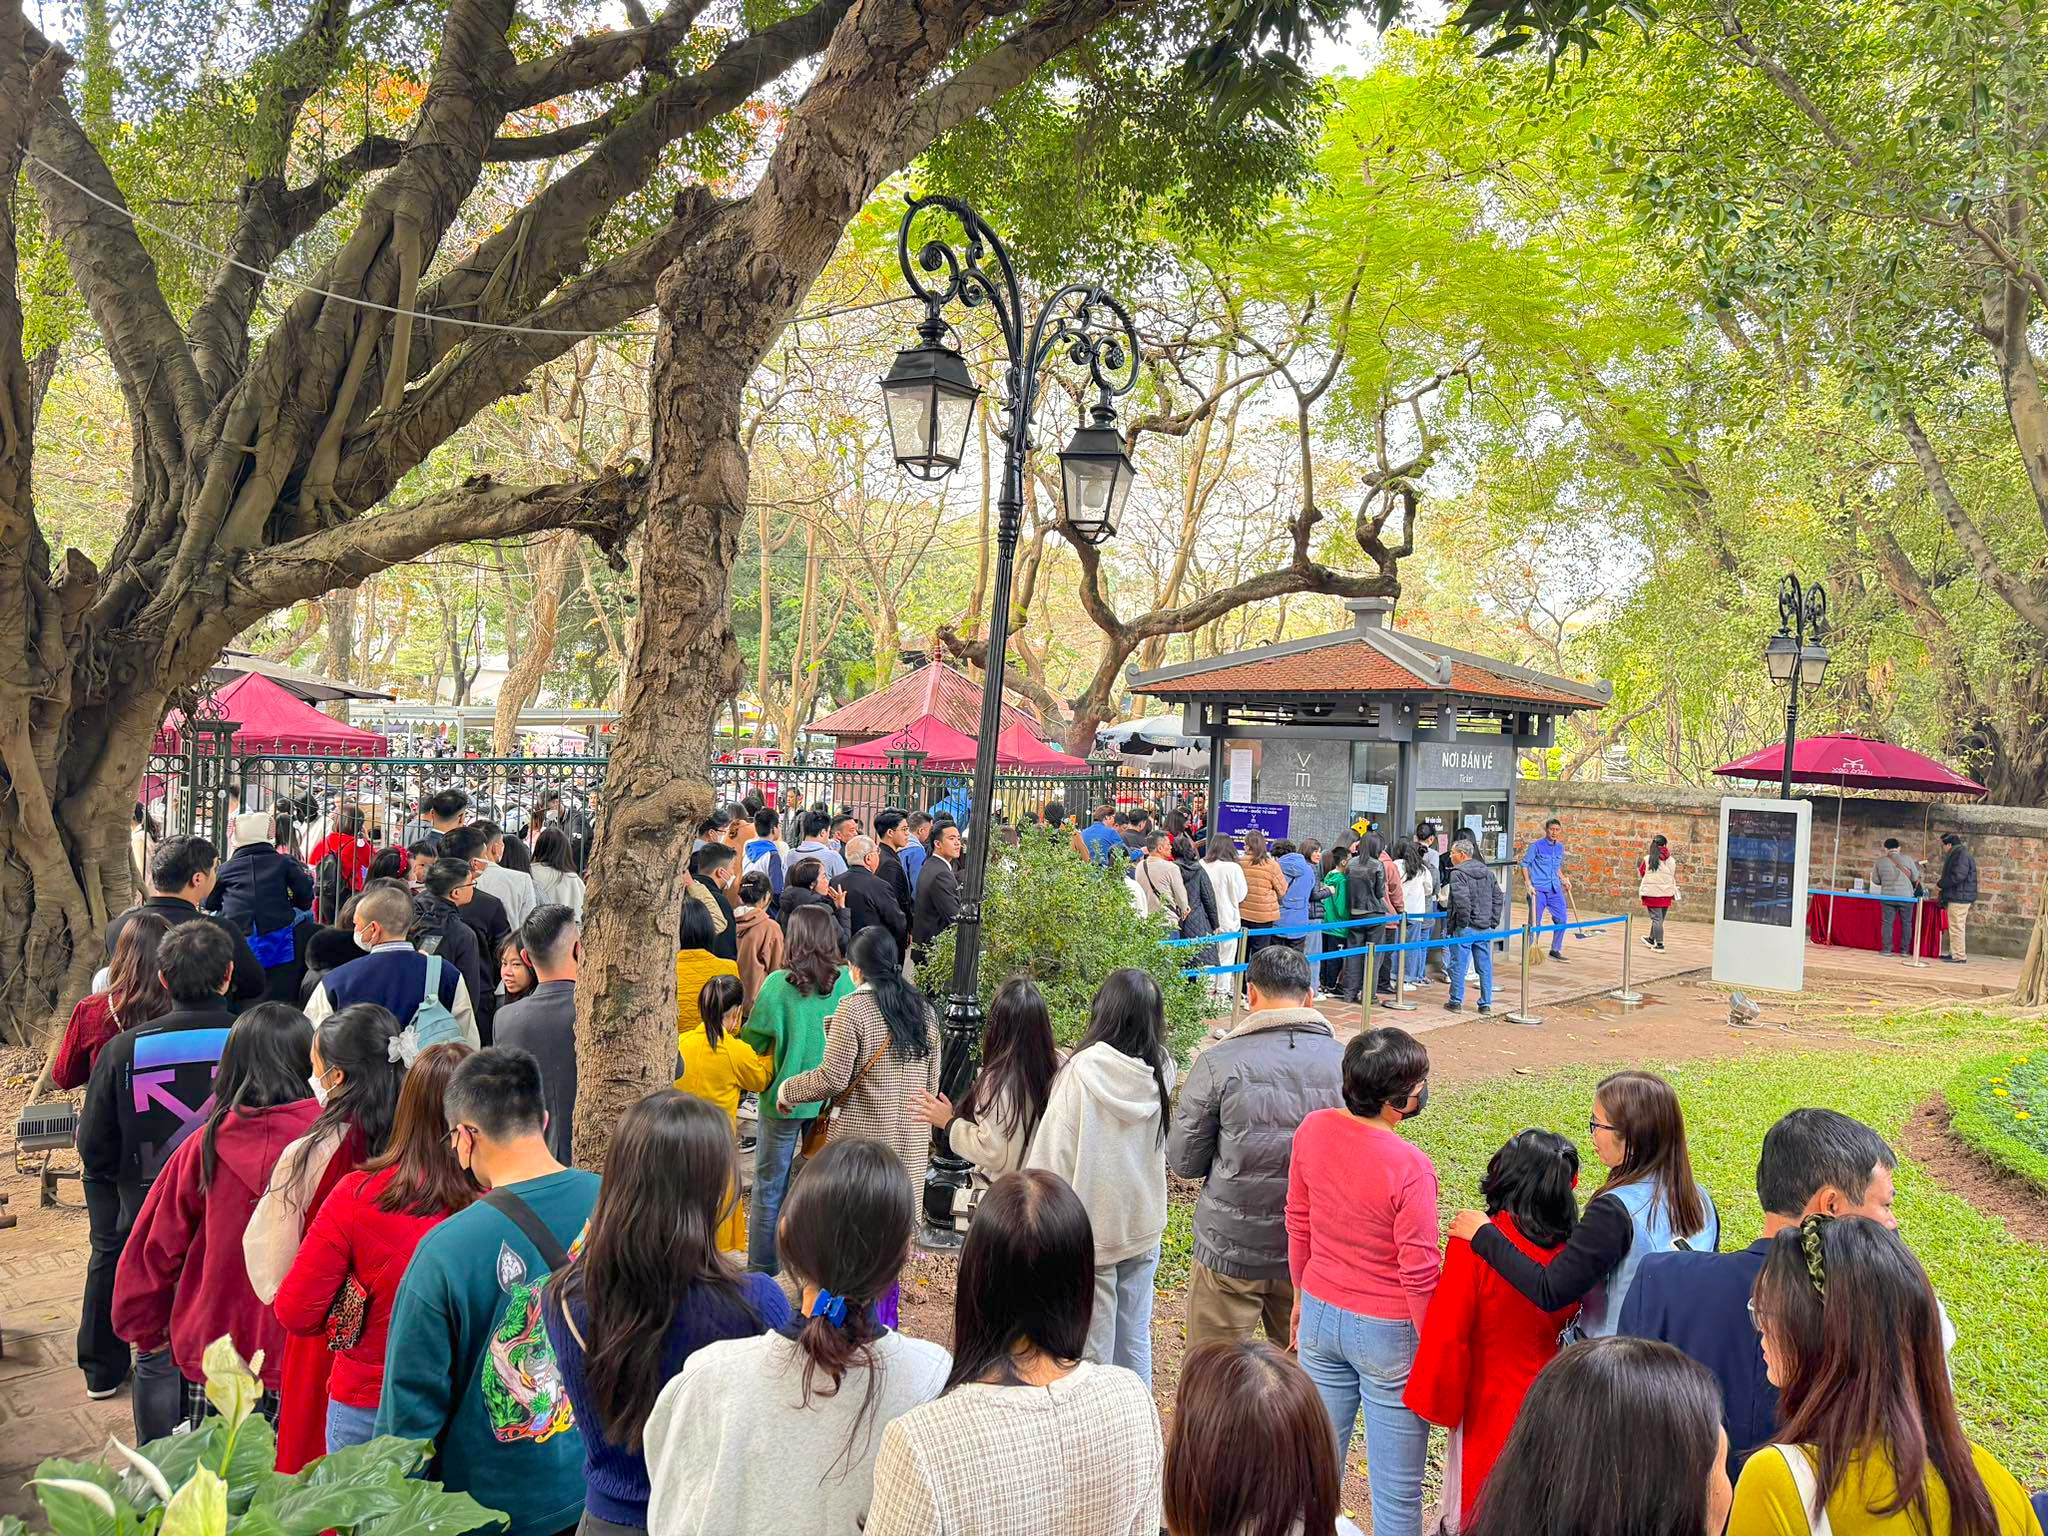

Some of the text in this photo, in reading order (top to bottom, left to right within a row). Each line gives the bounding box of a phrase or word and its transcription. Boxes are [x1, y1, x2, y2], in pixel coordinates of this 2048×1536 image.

[1442, 751, 1493, 770] NƠI BÁN VÉ
